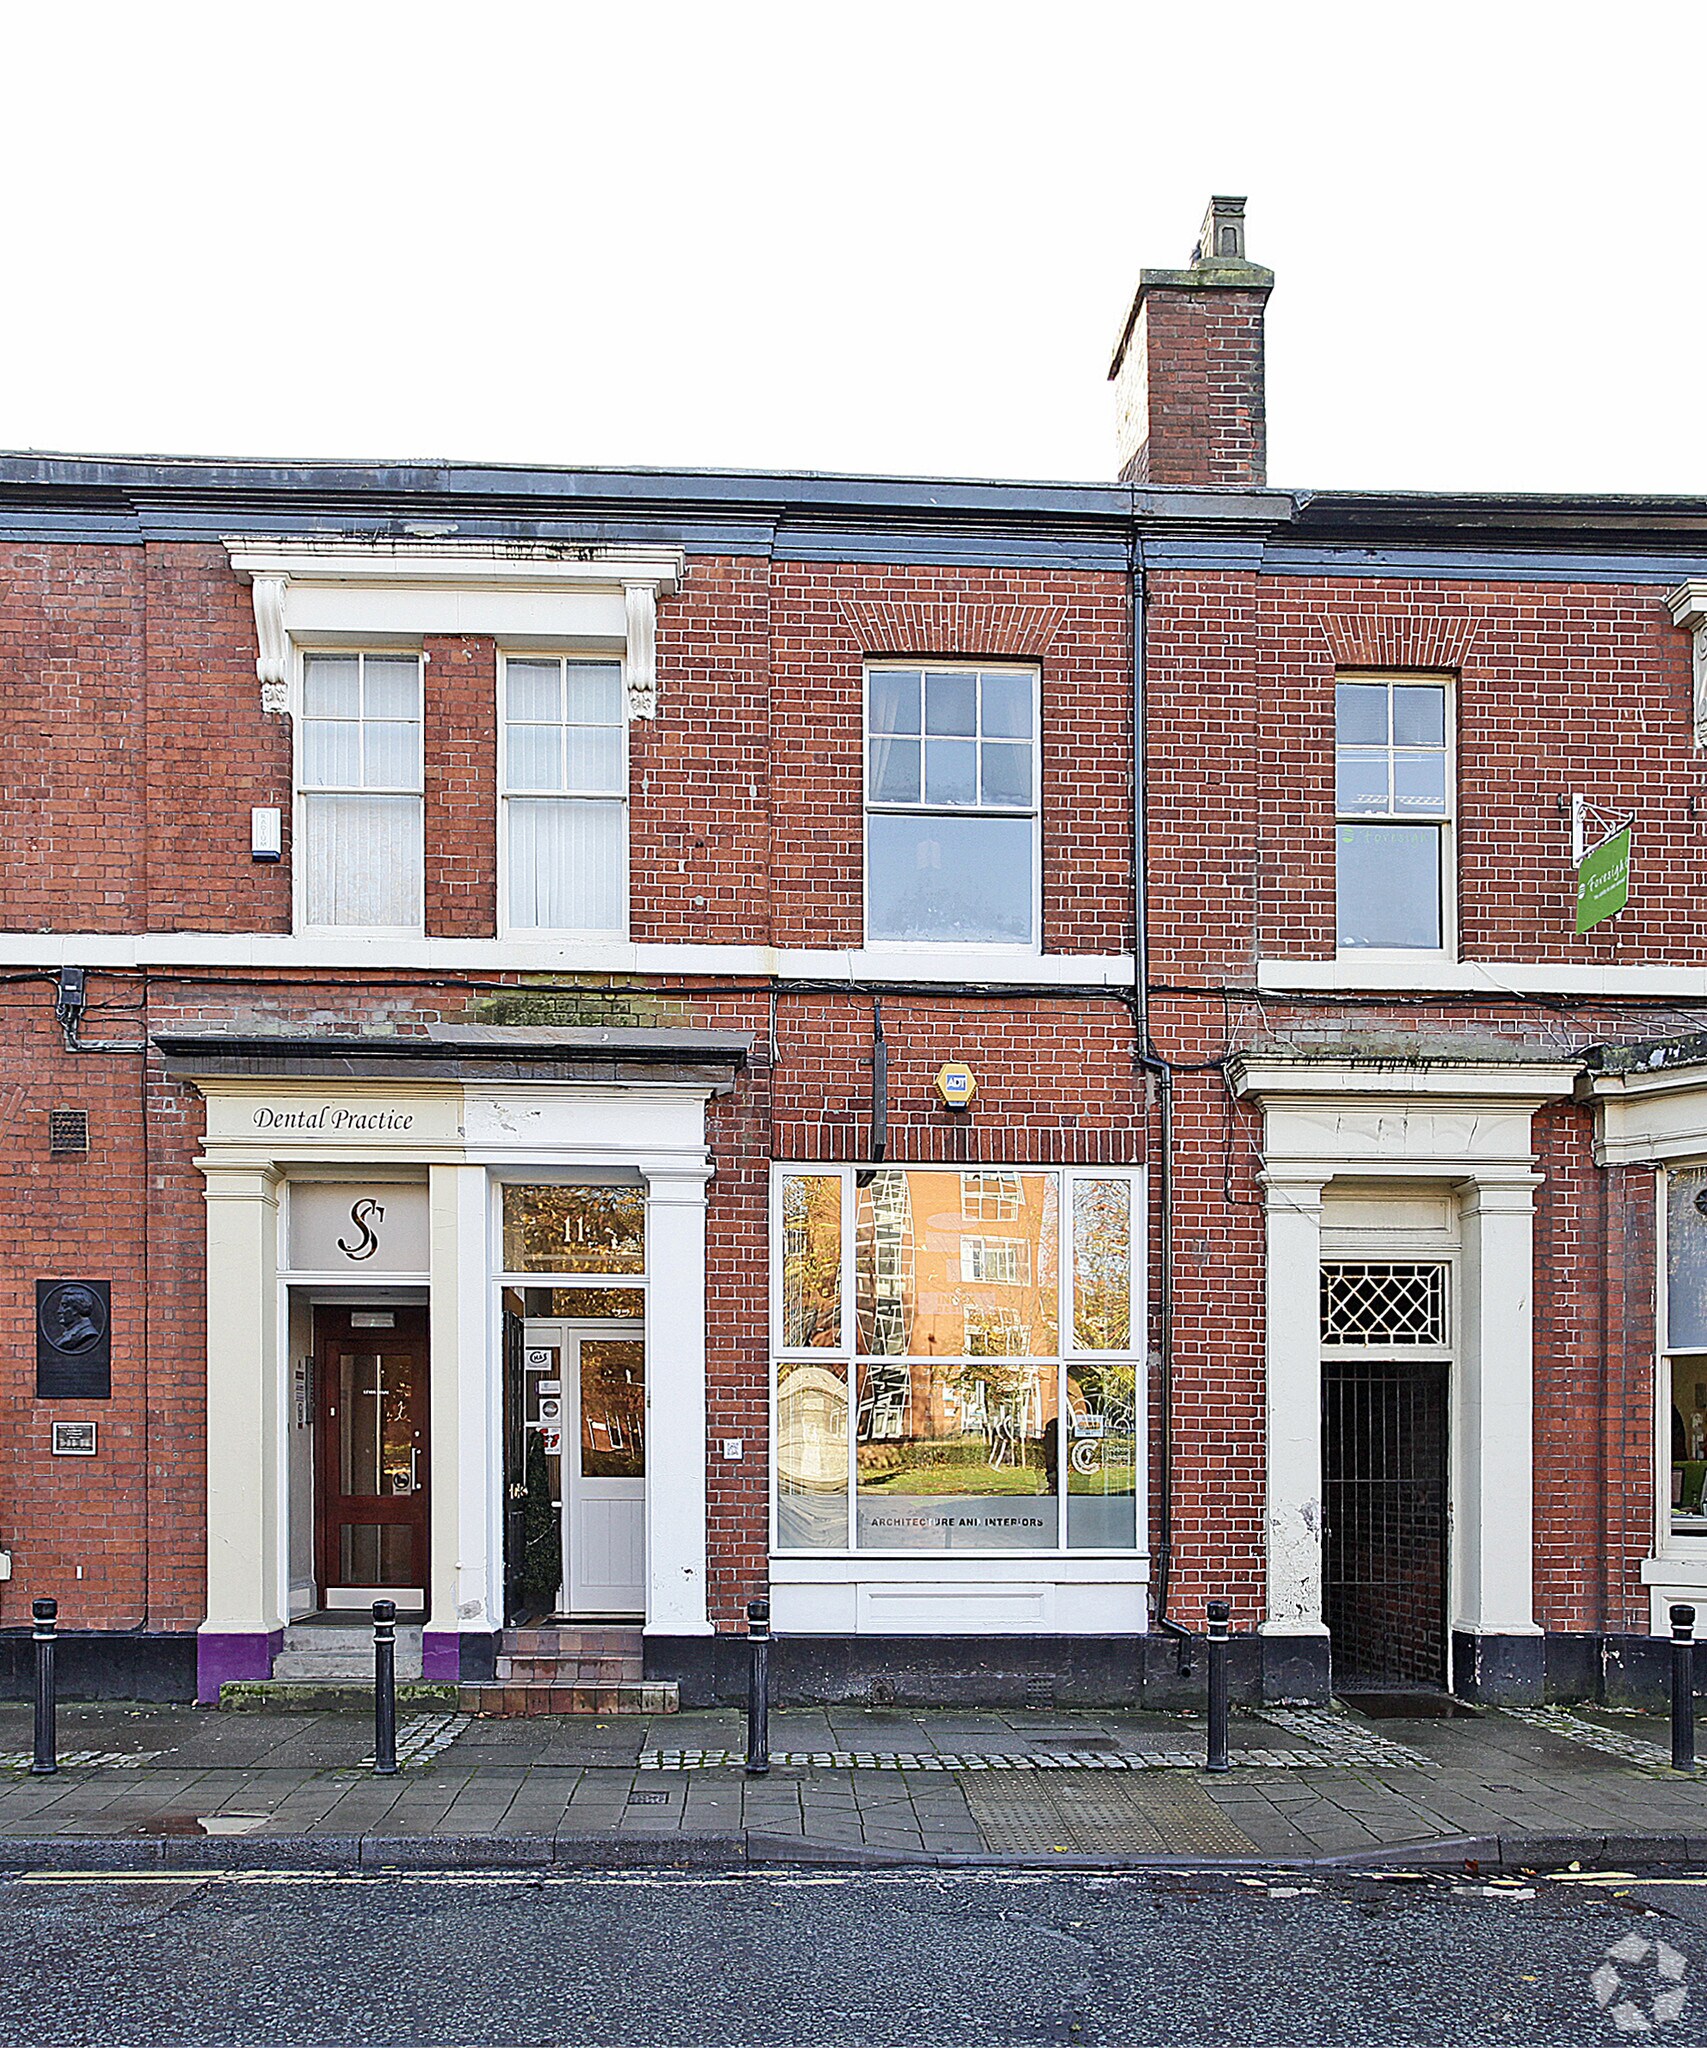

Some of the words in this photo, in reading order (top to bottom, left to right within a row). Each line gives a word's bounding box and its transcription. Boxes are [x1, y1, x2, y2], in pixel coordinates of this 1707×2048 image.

[947, 1077, 966, 1088] ADT
[253, 1106, 330, 1129] Dental
[331, 1109, 413, 1130] Practice
[563, 1215, 585, 1242] 11
[984, 1517, 1044, 1527] INTERIORS
